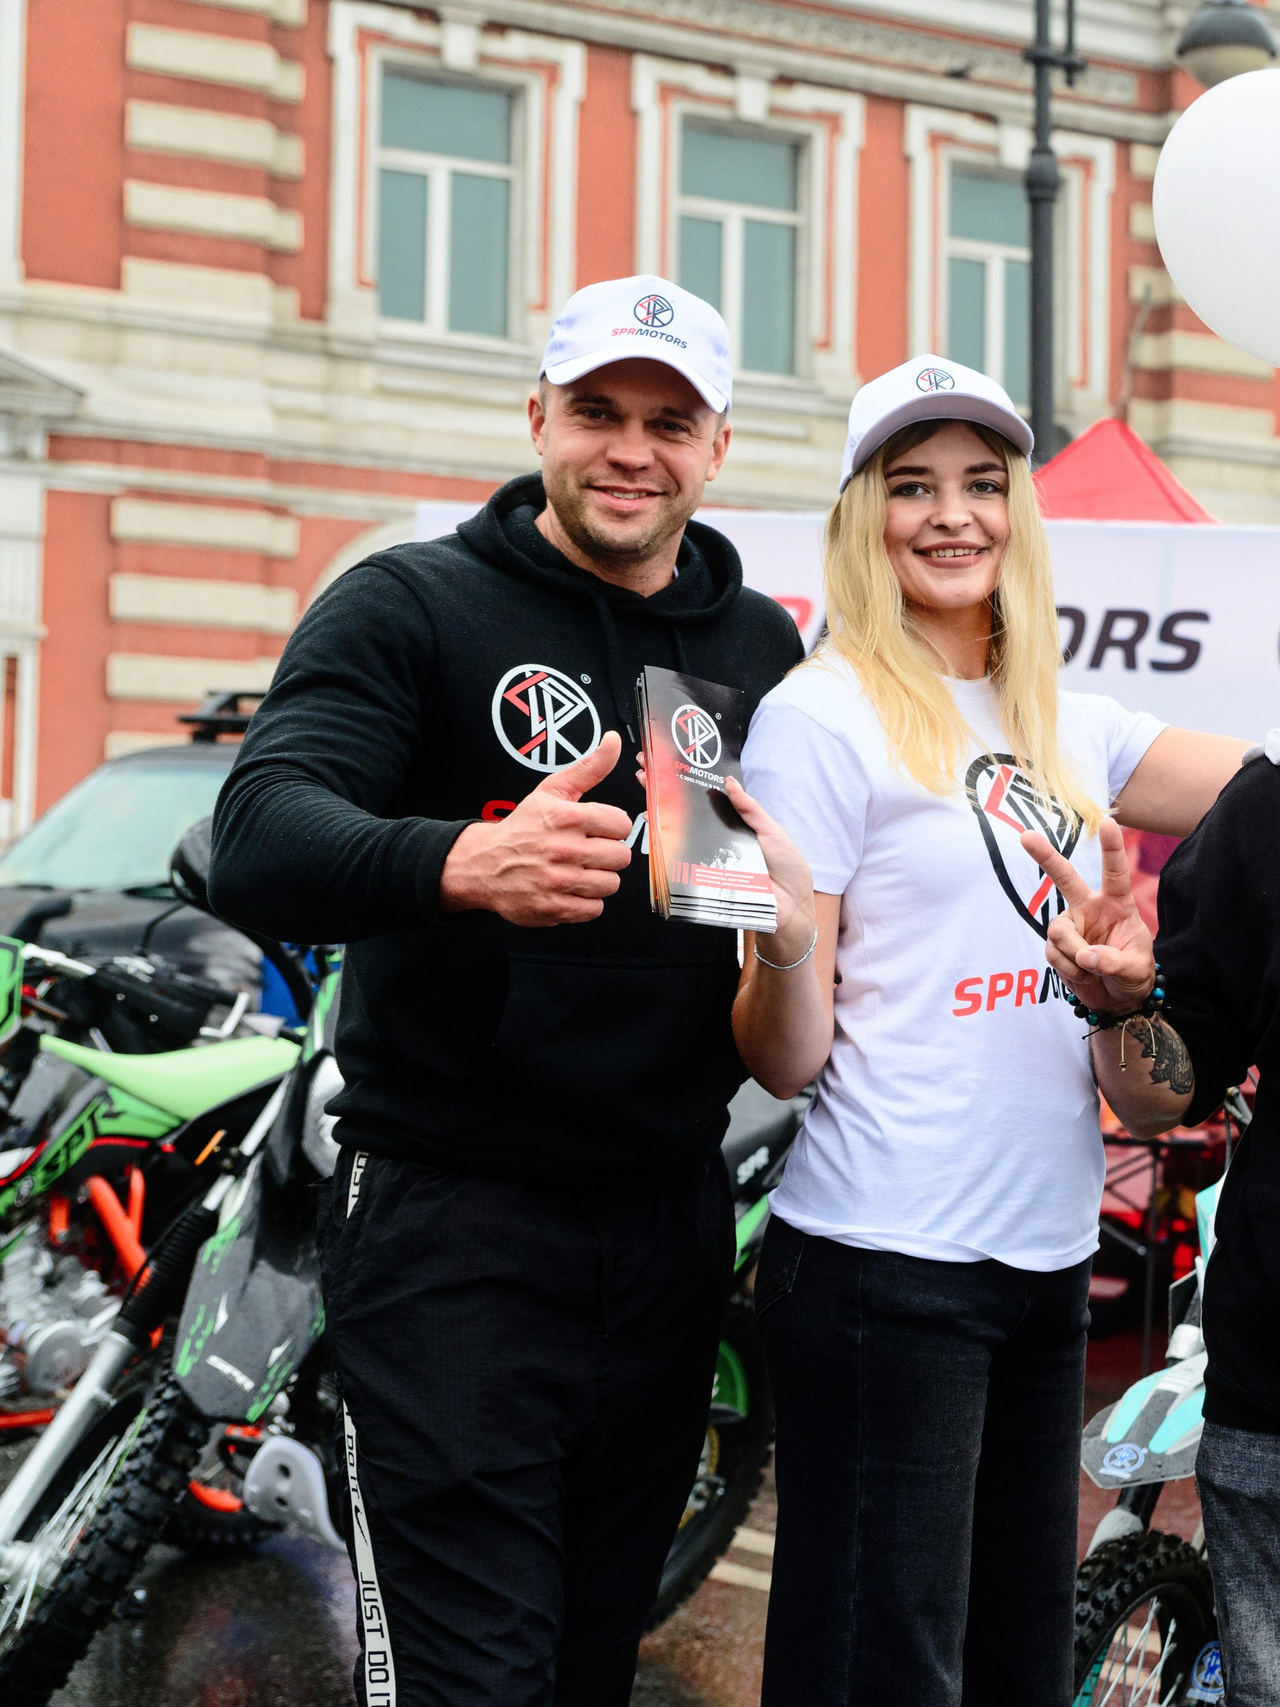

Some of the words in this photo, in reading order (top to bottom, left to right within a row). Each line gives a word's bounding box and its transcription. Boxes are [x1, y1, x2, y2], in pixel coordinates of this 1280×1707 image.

[611, 328, 688, 349] SPRMOTORS
[673, 761, 725, 784] SPRMOTORS
[951, 966, 1073, 1018] SPRM
[360, 1571, 385, 1639] JUST
[368, 1650, 390, 1684] DO
